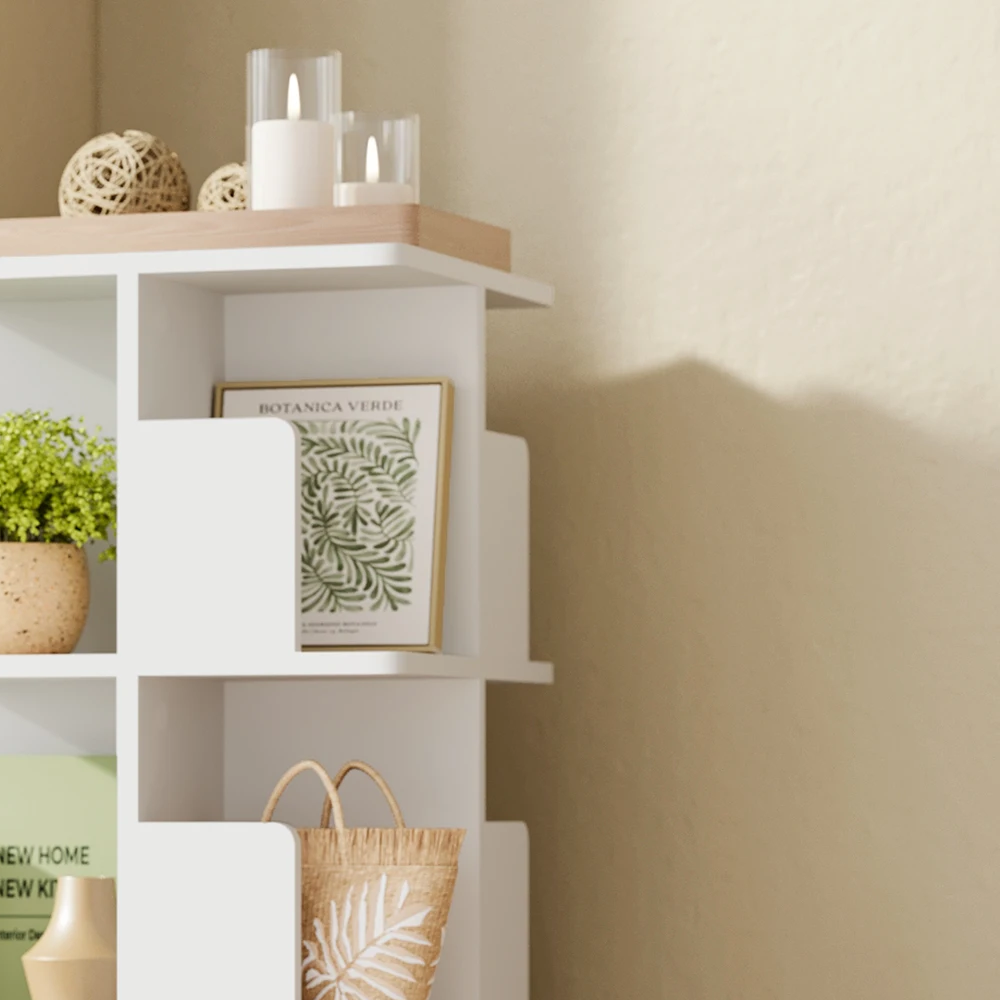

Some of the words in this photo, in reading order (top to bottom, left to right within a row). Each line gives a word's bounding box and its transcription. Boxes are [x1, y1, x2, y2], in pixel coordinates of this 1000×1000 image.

[259, 401, 343, 414] BOTANICA
[347, 400, 402, 412] VERDE
[38, 846, 90, 865] HOME
